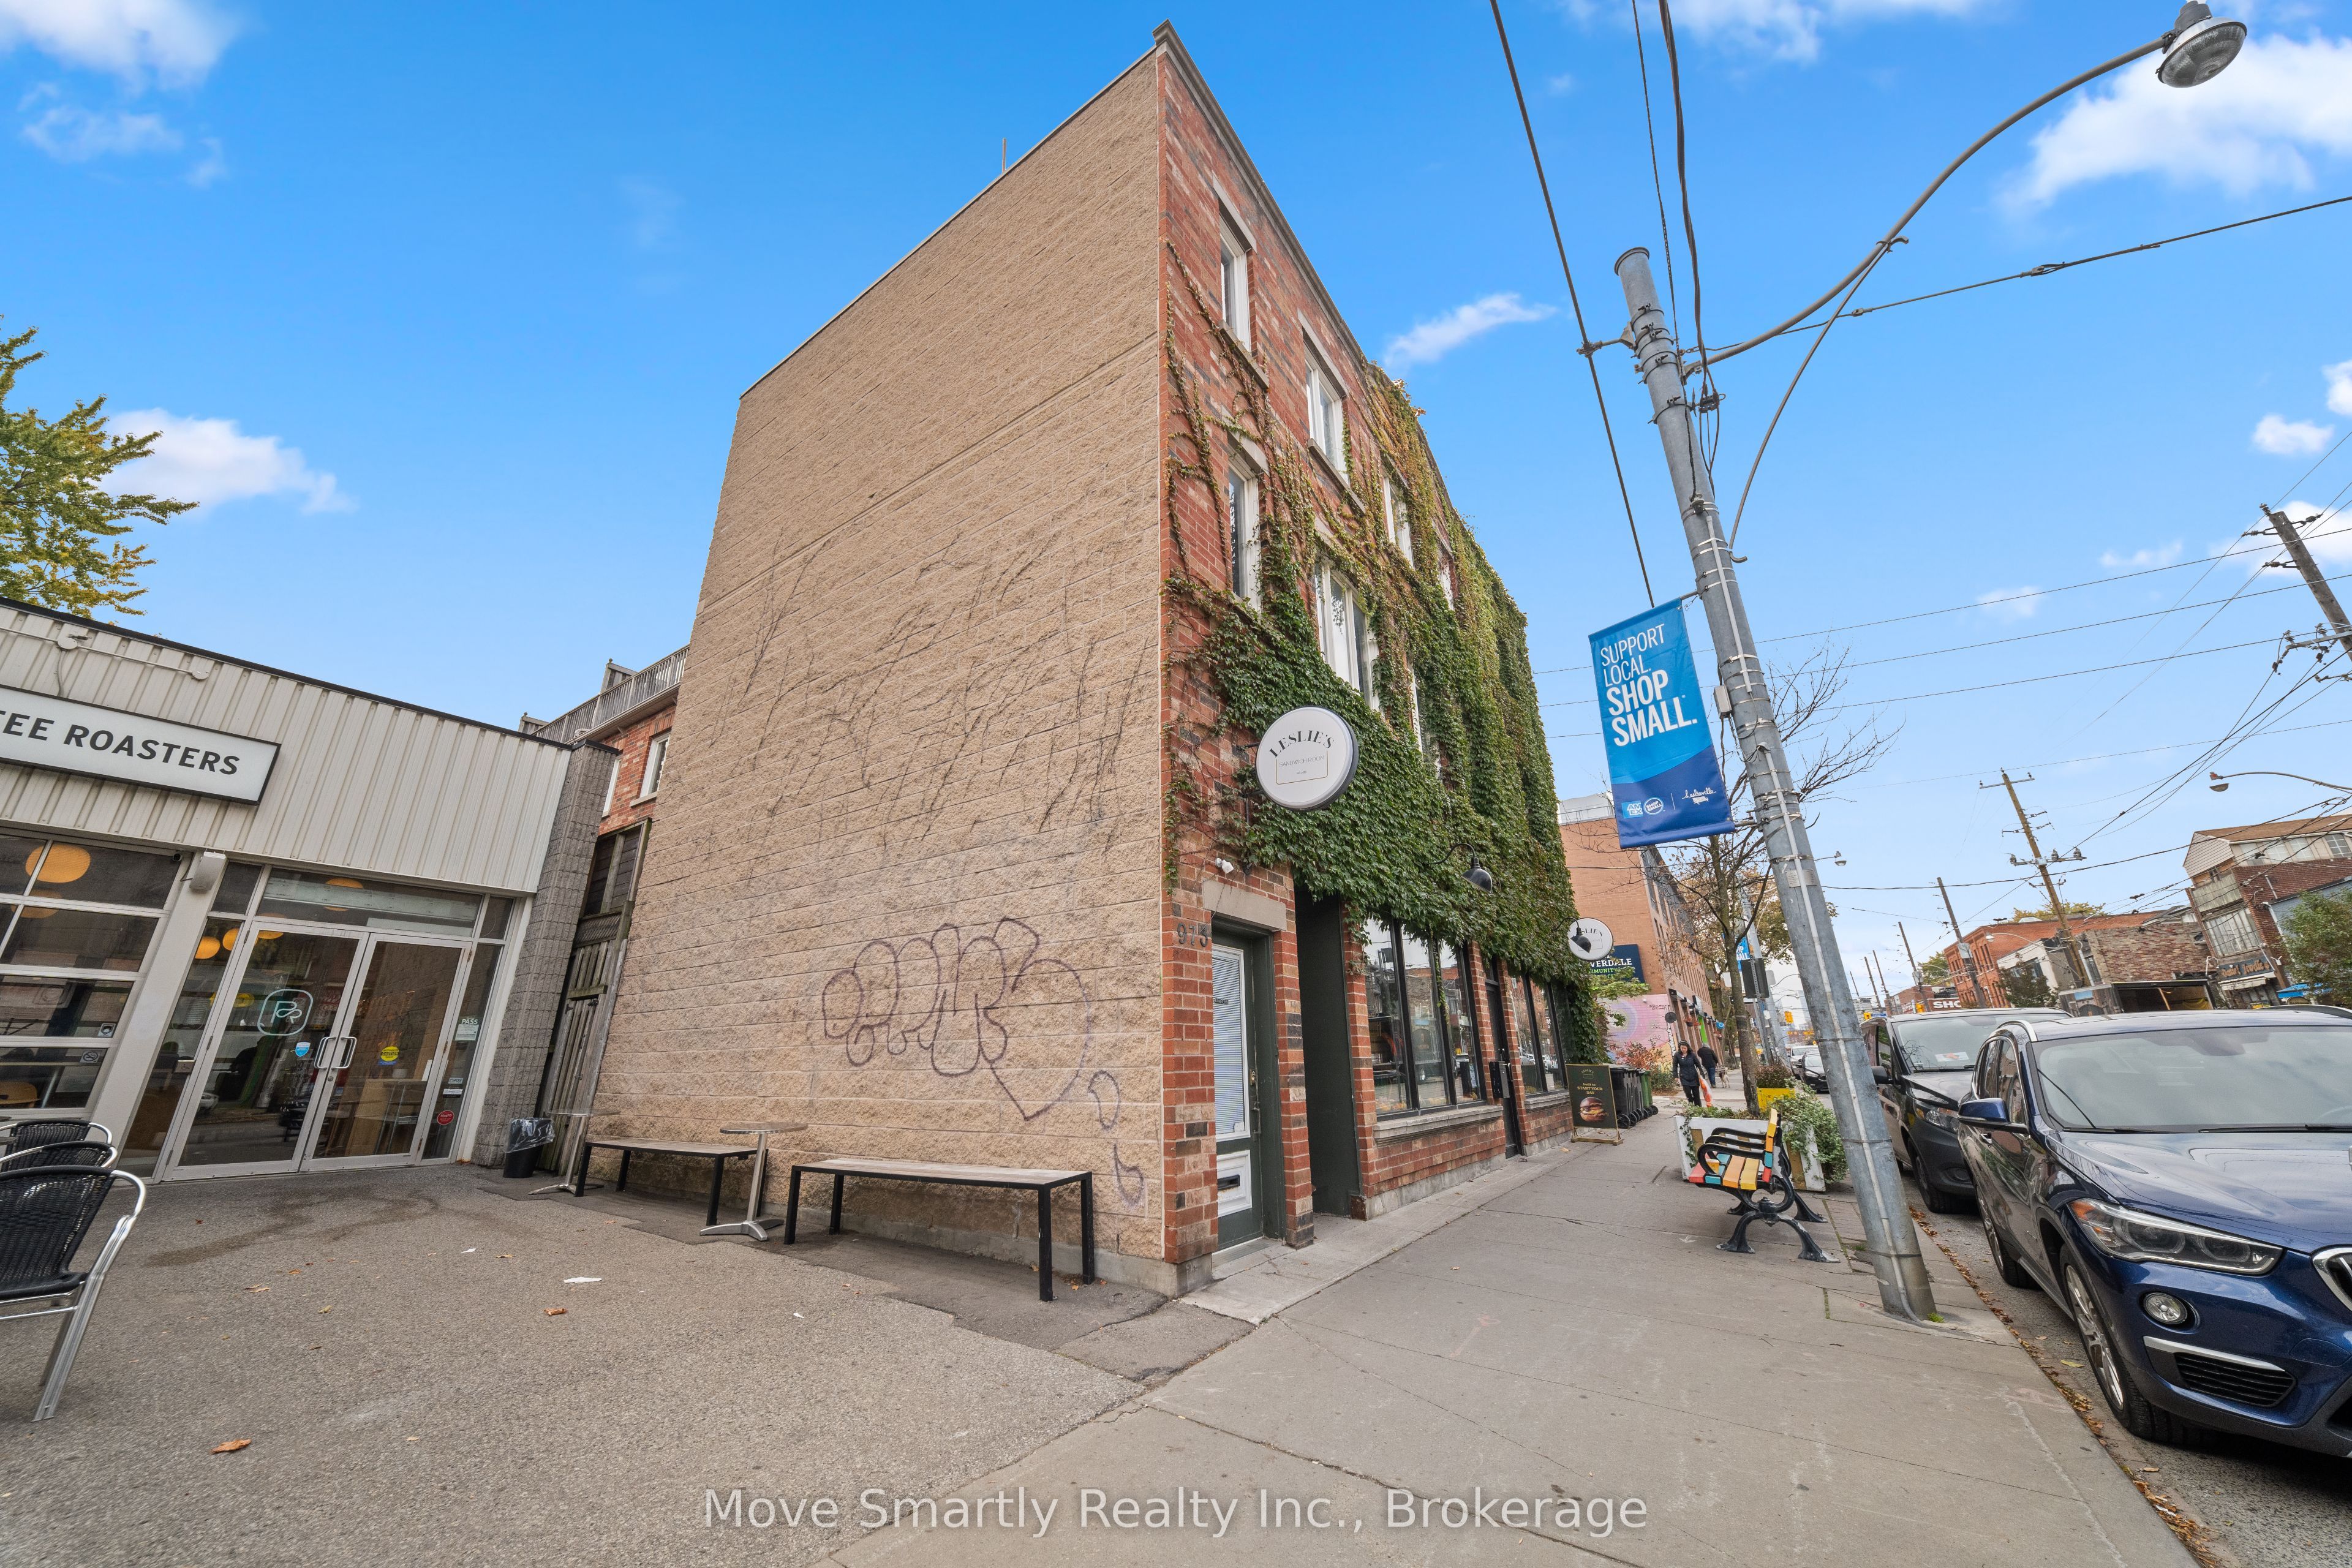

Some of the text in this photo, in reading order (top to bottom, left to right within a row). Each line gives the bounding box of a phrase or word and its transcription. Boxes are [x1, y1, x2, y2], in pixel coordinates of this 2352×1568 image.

[1600, 624, 1665, 666] SUPPORT
[1604, 655, 1651, 687] LOCAL.
[1607, 669, 1668, 716] SHOP
[1611, 696, 1698, 747] SMALL.
[0, 710, 240, 775] EE ROASTERS
[1269, 730, 1335, 758] LESLIE'S
[1279, 758, 1308, 767] SANDWICH
[1647, 803, 1662, 812] SMALL
[1177, 922, 1208, 948] 973
